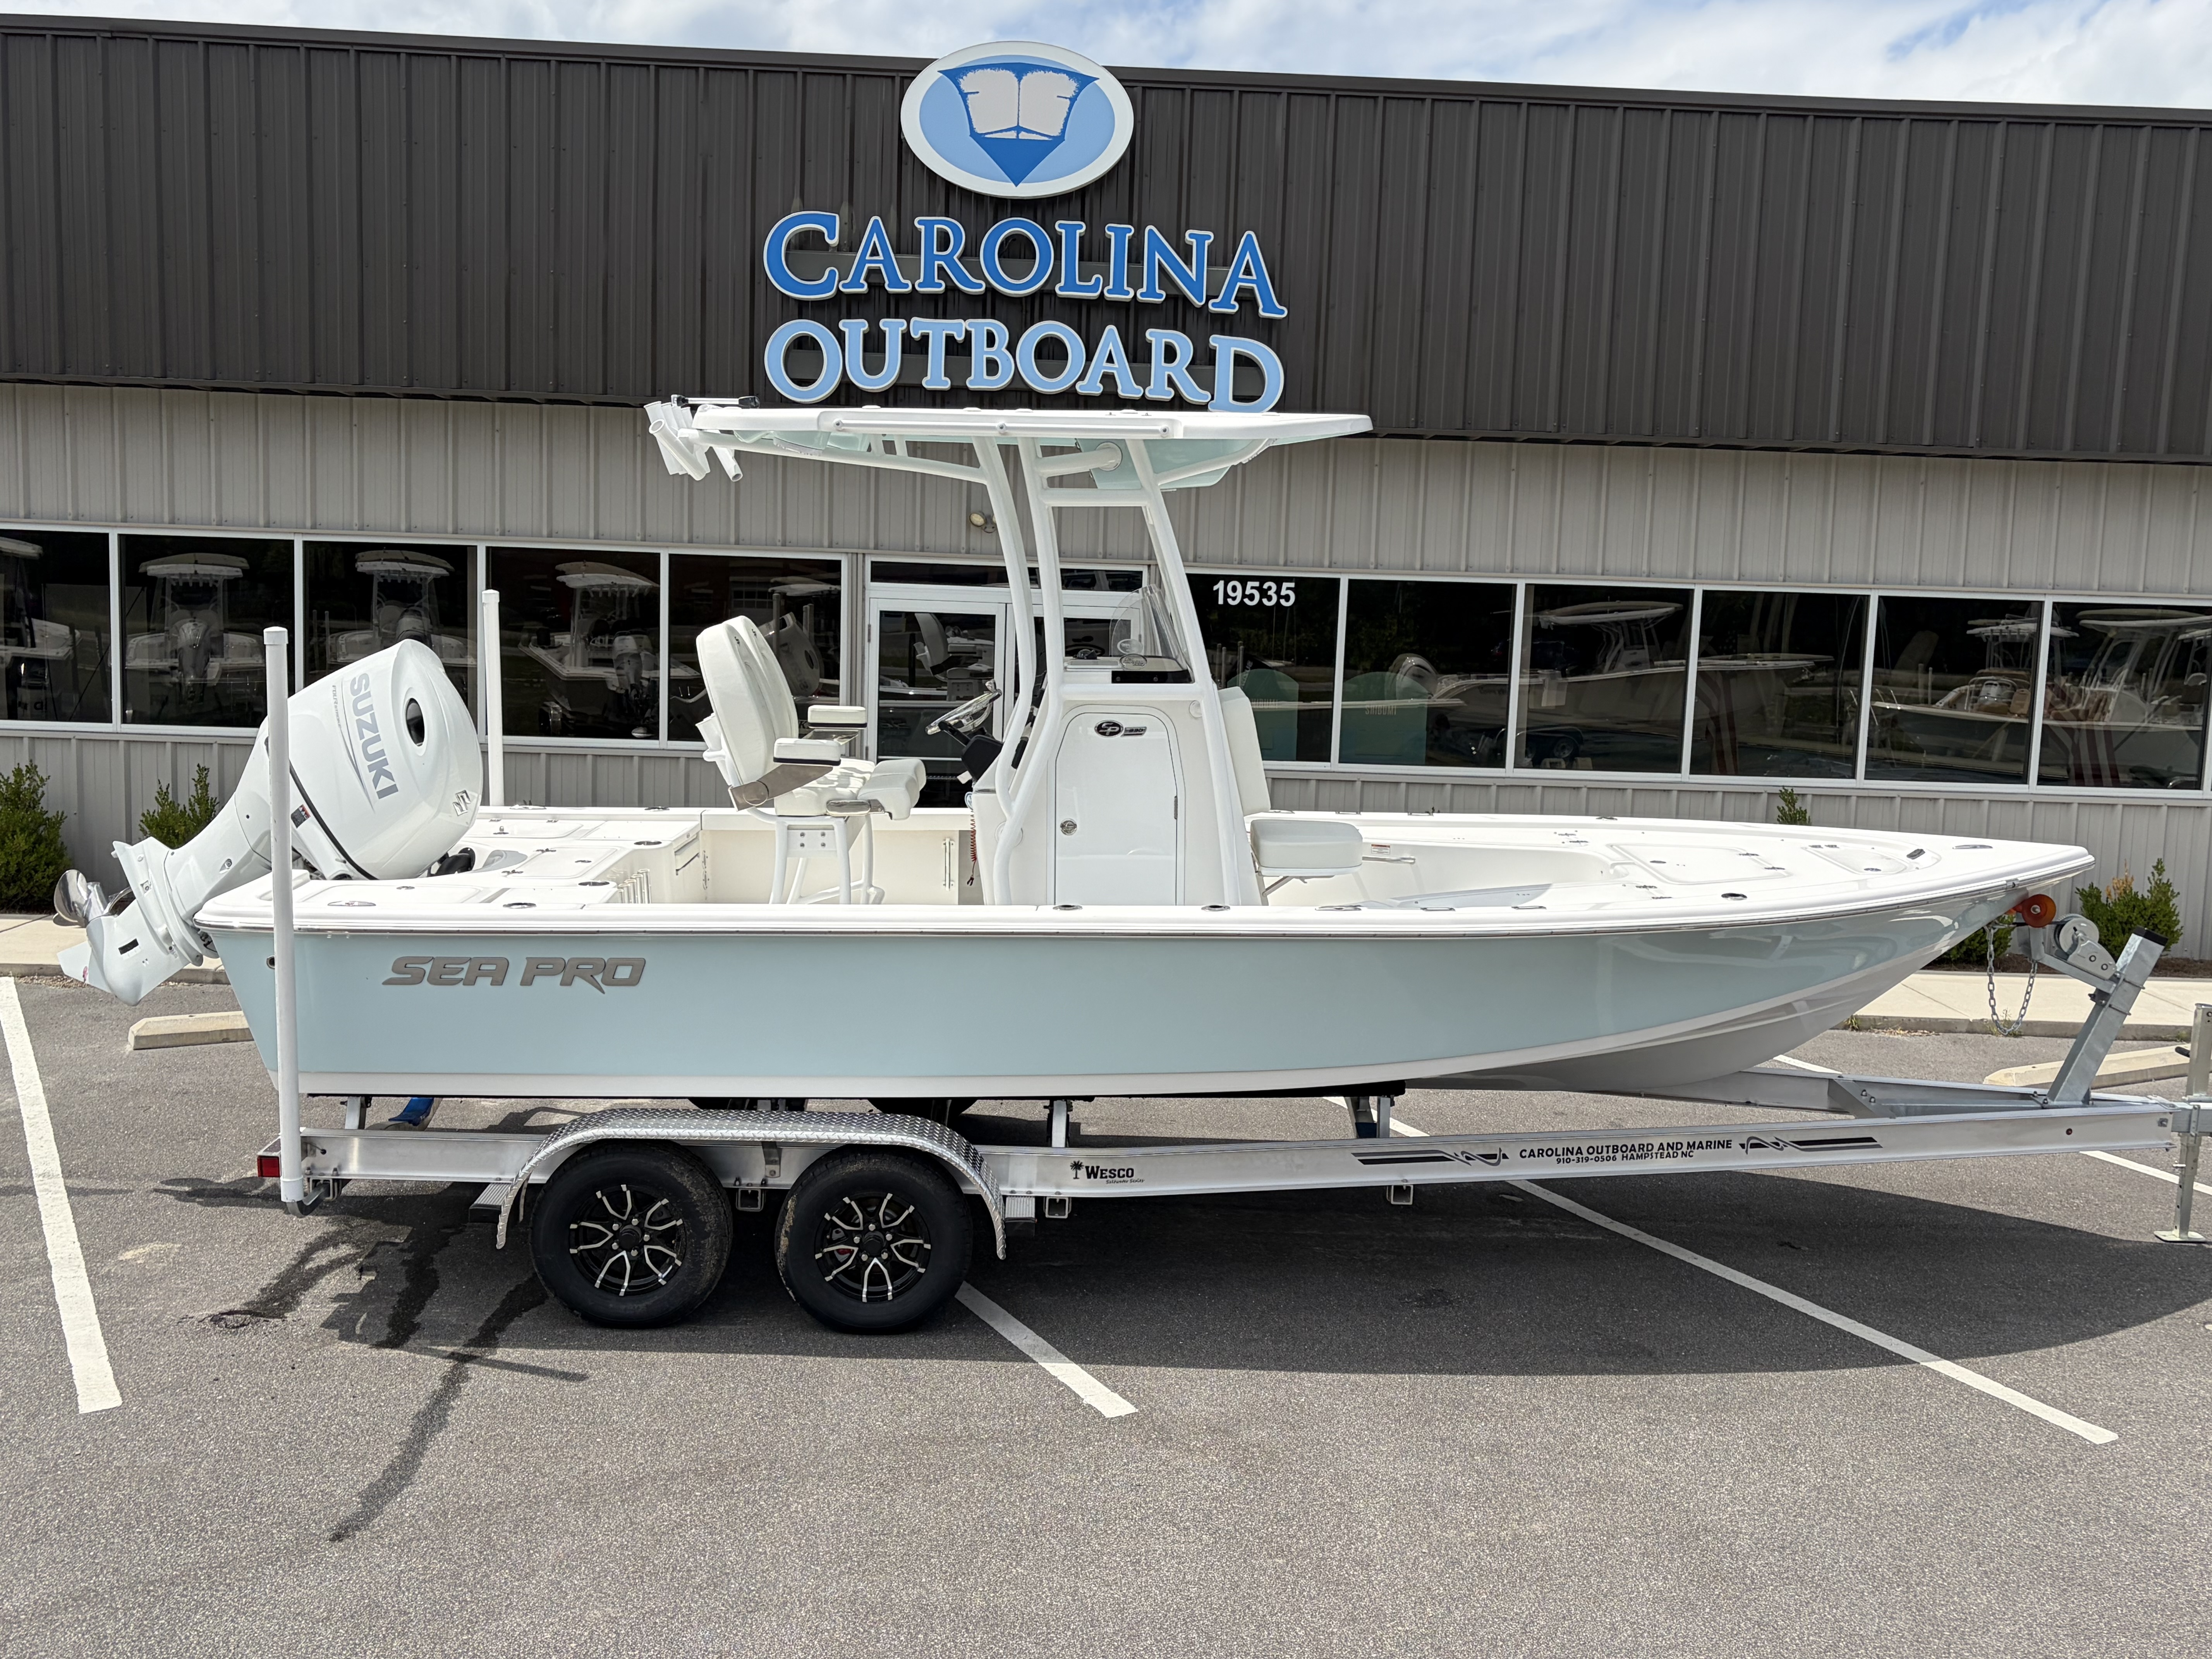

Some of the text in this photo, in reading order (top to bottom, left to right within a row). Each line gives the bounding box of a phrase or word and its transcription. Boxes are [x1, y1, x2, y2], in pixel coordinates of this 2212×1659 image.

[763, 210, 1288, 318] CAROLINA
[764, 316, 1285, 413] OUTBOARD
[1213, 580, 1296, 606] 19535
[350, 673, 399, 800] SUZUKI
[382, 956, 646, 994] SEA PRO
[1519, 1140, 1733, 1159] CAROLINA OUTBOARD AND MARINE
[1556, 1155, 1617, 1164] 910-319-0506
[1622, 1151, 1679, 1161] HAMPSTEAD
